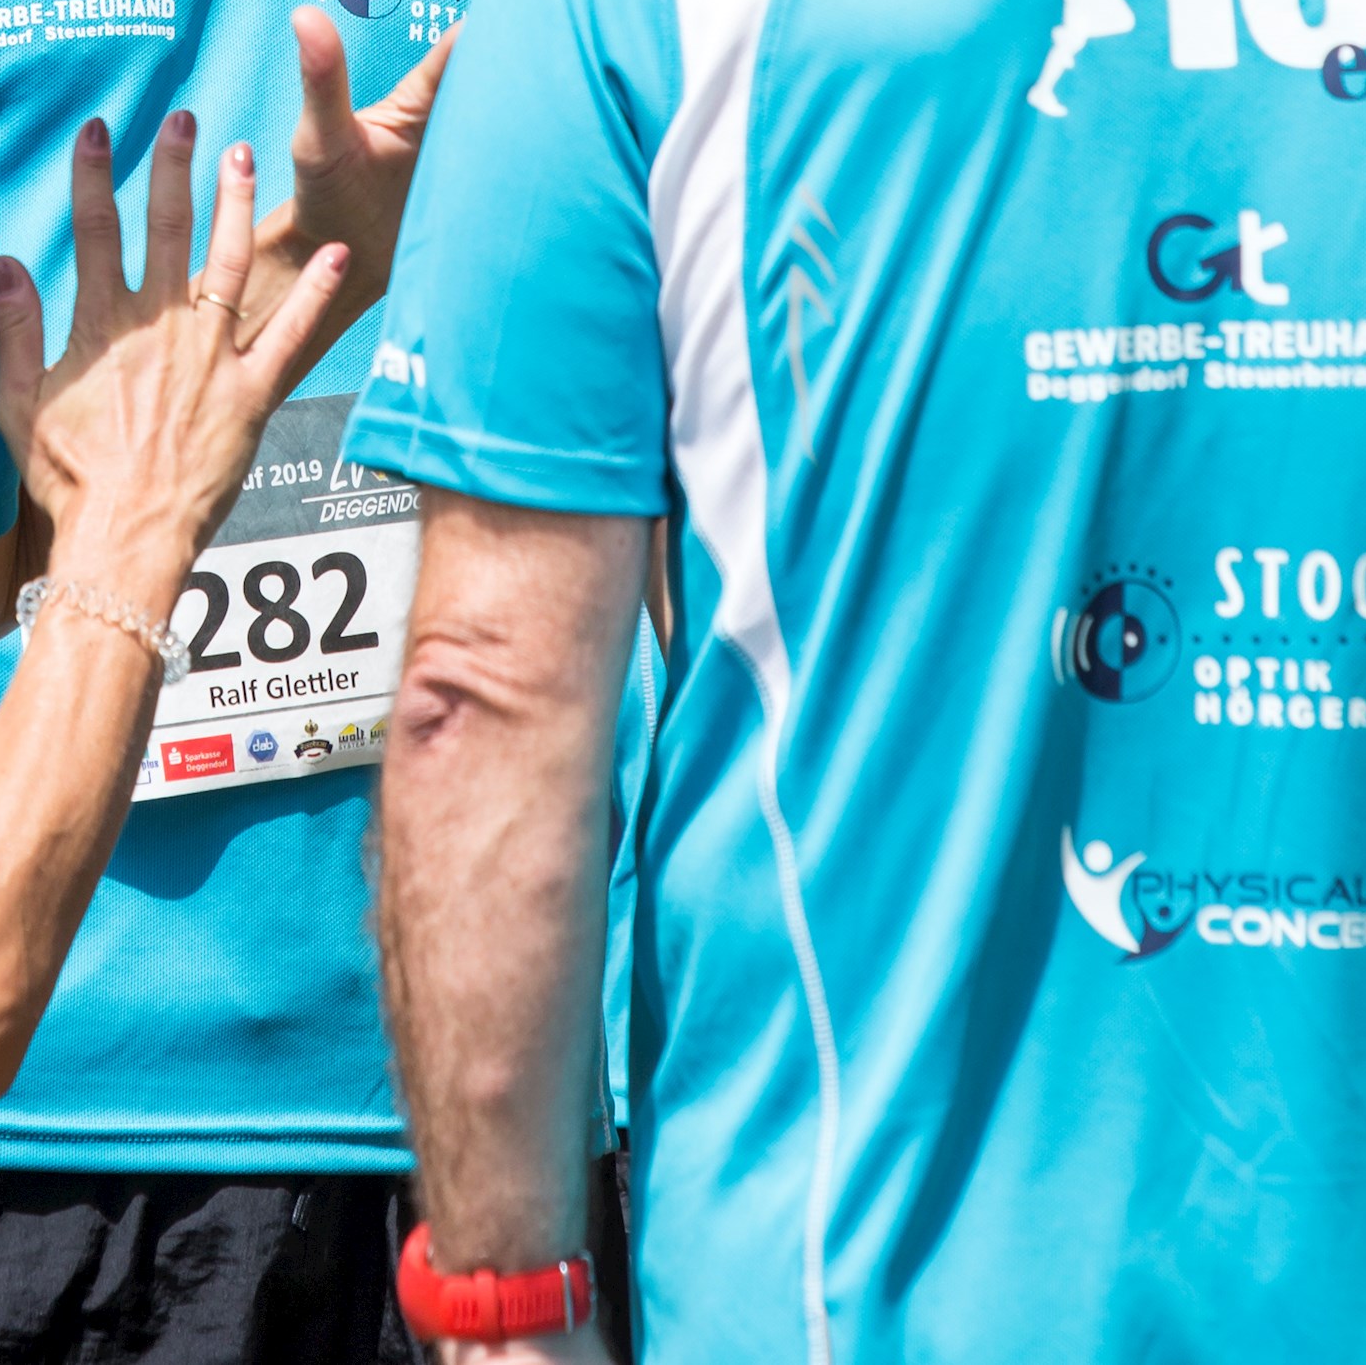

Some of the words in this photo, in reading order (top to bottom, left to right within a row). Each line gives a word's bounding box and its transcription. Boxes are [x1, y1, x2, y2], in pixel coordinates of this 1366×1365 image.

[44, 22, 176, 41] Steuerberatung
[1025, 363, 1190, 404] Deggendorf
[242, 466, 264, 491] uf
[269, 459, 323, 487] 2019
[320, 492, 423, 524] DEGGENDO
[181, 551, 379, 674] 282
[209, 678, 257, 708] Ralf
[266, 668, 359, 699] Glettler
[1192, 655, 1333, 693] OPTIK
[184, 750, 222, 763] Sparkasse
[186, 759, 229, 772] Deggendorf
